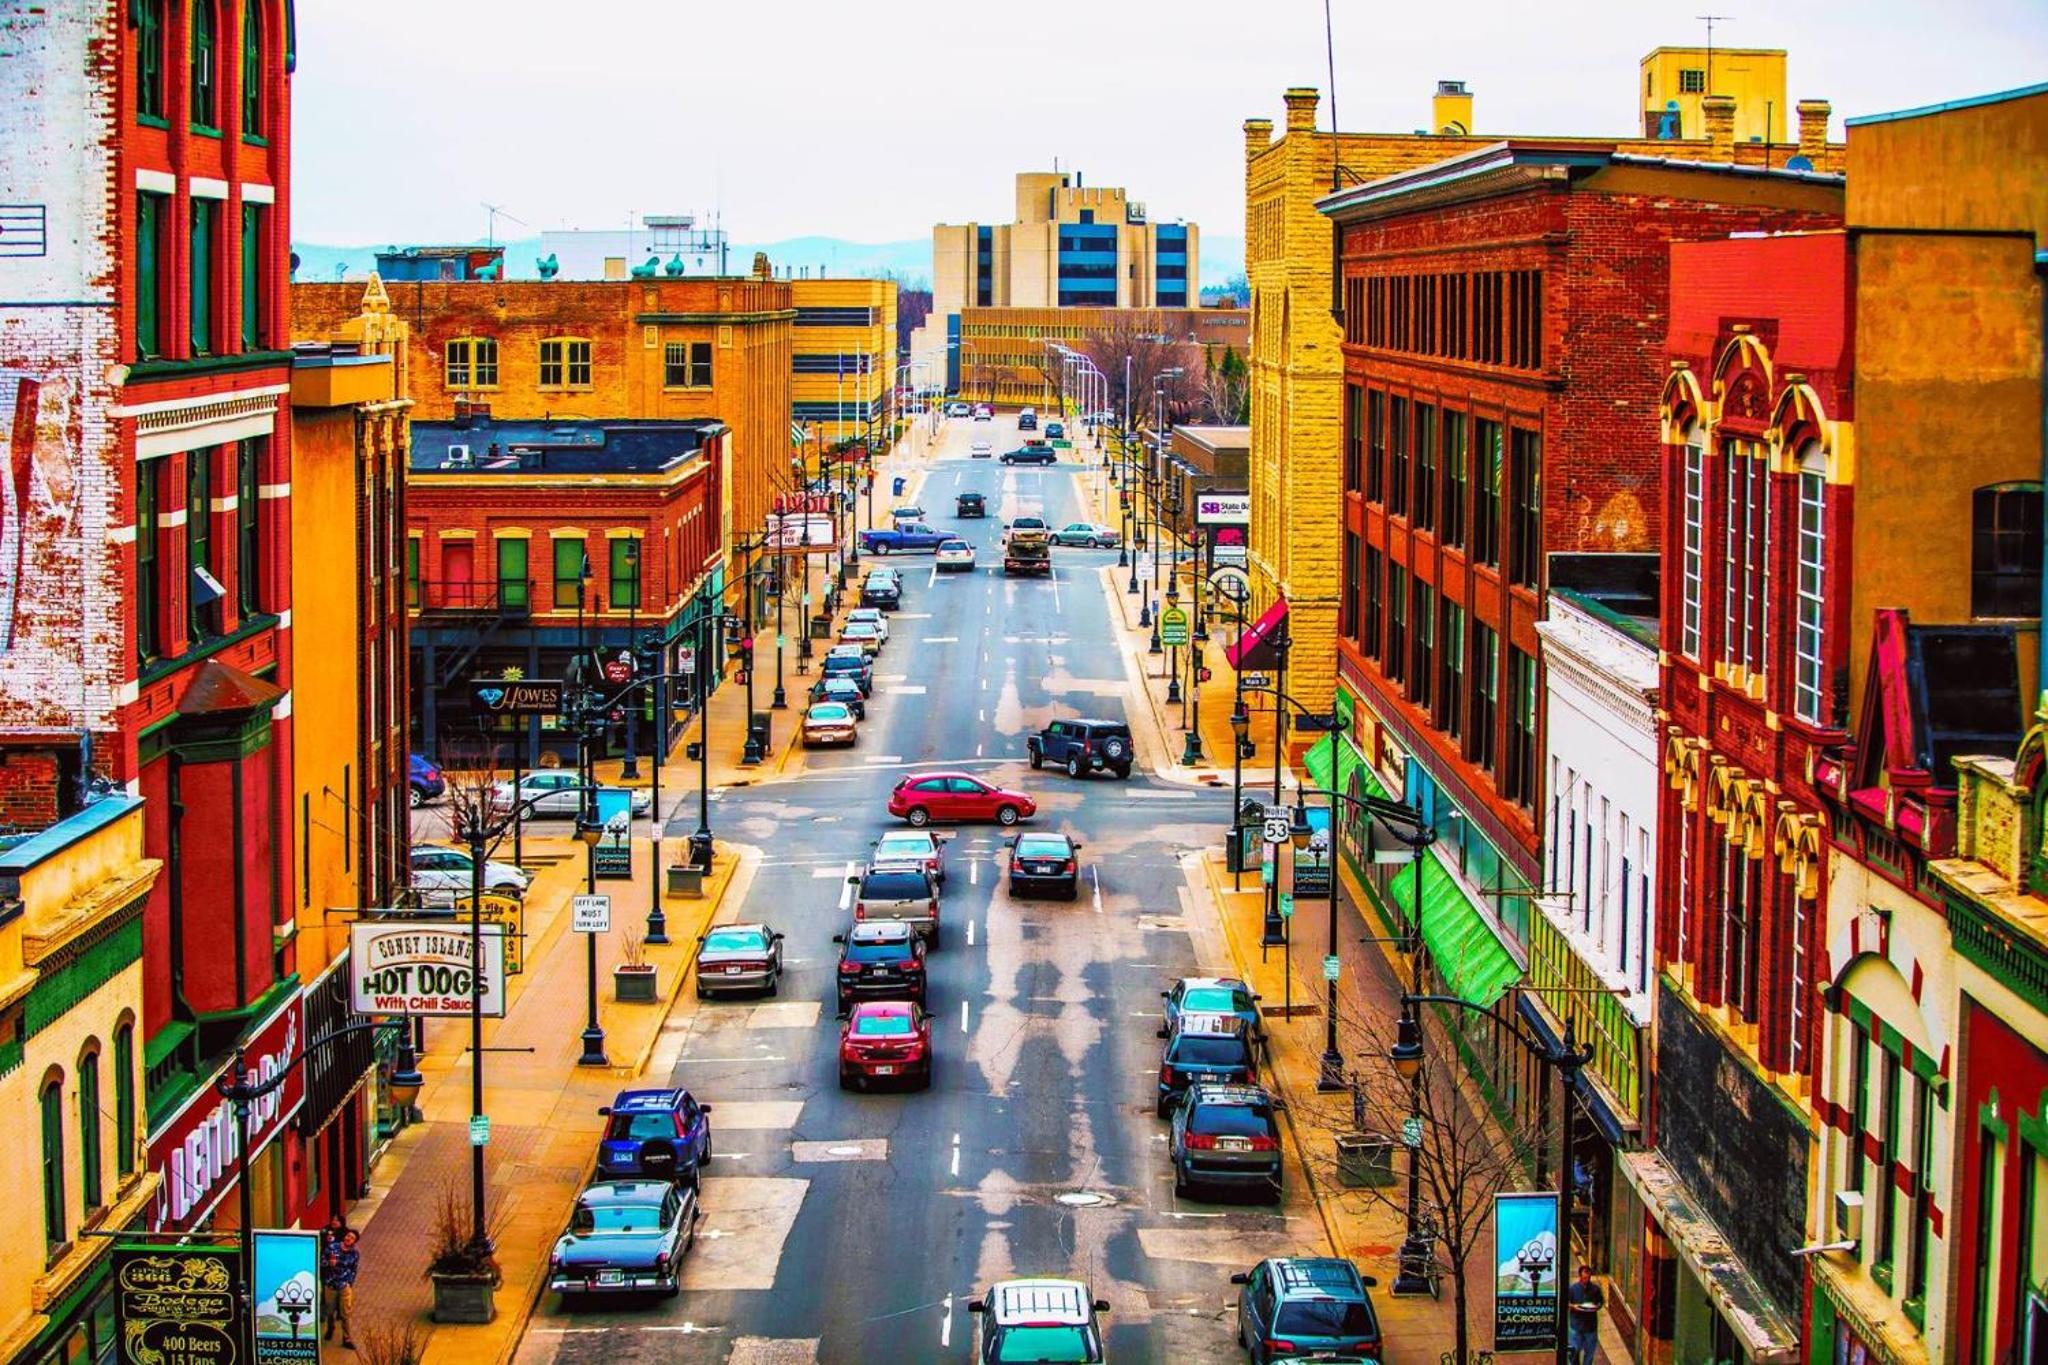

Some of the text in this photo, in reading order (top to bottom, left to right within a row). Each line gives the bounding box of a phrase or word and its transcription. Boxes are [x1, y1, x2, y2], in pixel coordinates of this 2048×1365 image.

[1201, 502, 1220, 513] SB
[490, 687, 557, 709] HOWES
[1267, 824, 1287, 838] 53
[581, 910, 602, 918] MUST
[379, 936, 472, 959] CONEY ISLAND
[362, 965, 489, 996] HOT DOGS
[375, 997, 474, 1011] With Chili Sauc
[172, 1054, 276, 1221] LEITHLD
[134, 1293, 223, 1306] Bodega
[1498, 1306, 1554, 1314] DOWNTOWN
[163, 1336, 221, 1352] 400 Beers
[258, 1340, 314, 1349] HISTORIC
[171, 1353, 216, 1365] 15 Taps
[258, 1348, 316, 1357] DOWNTOWN
